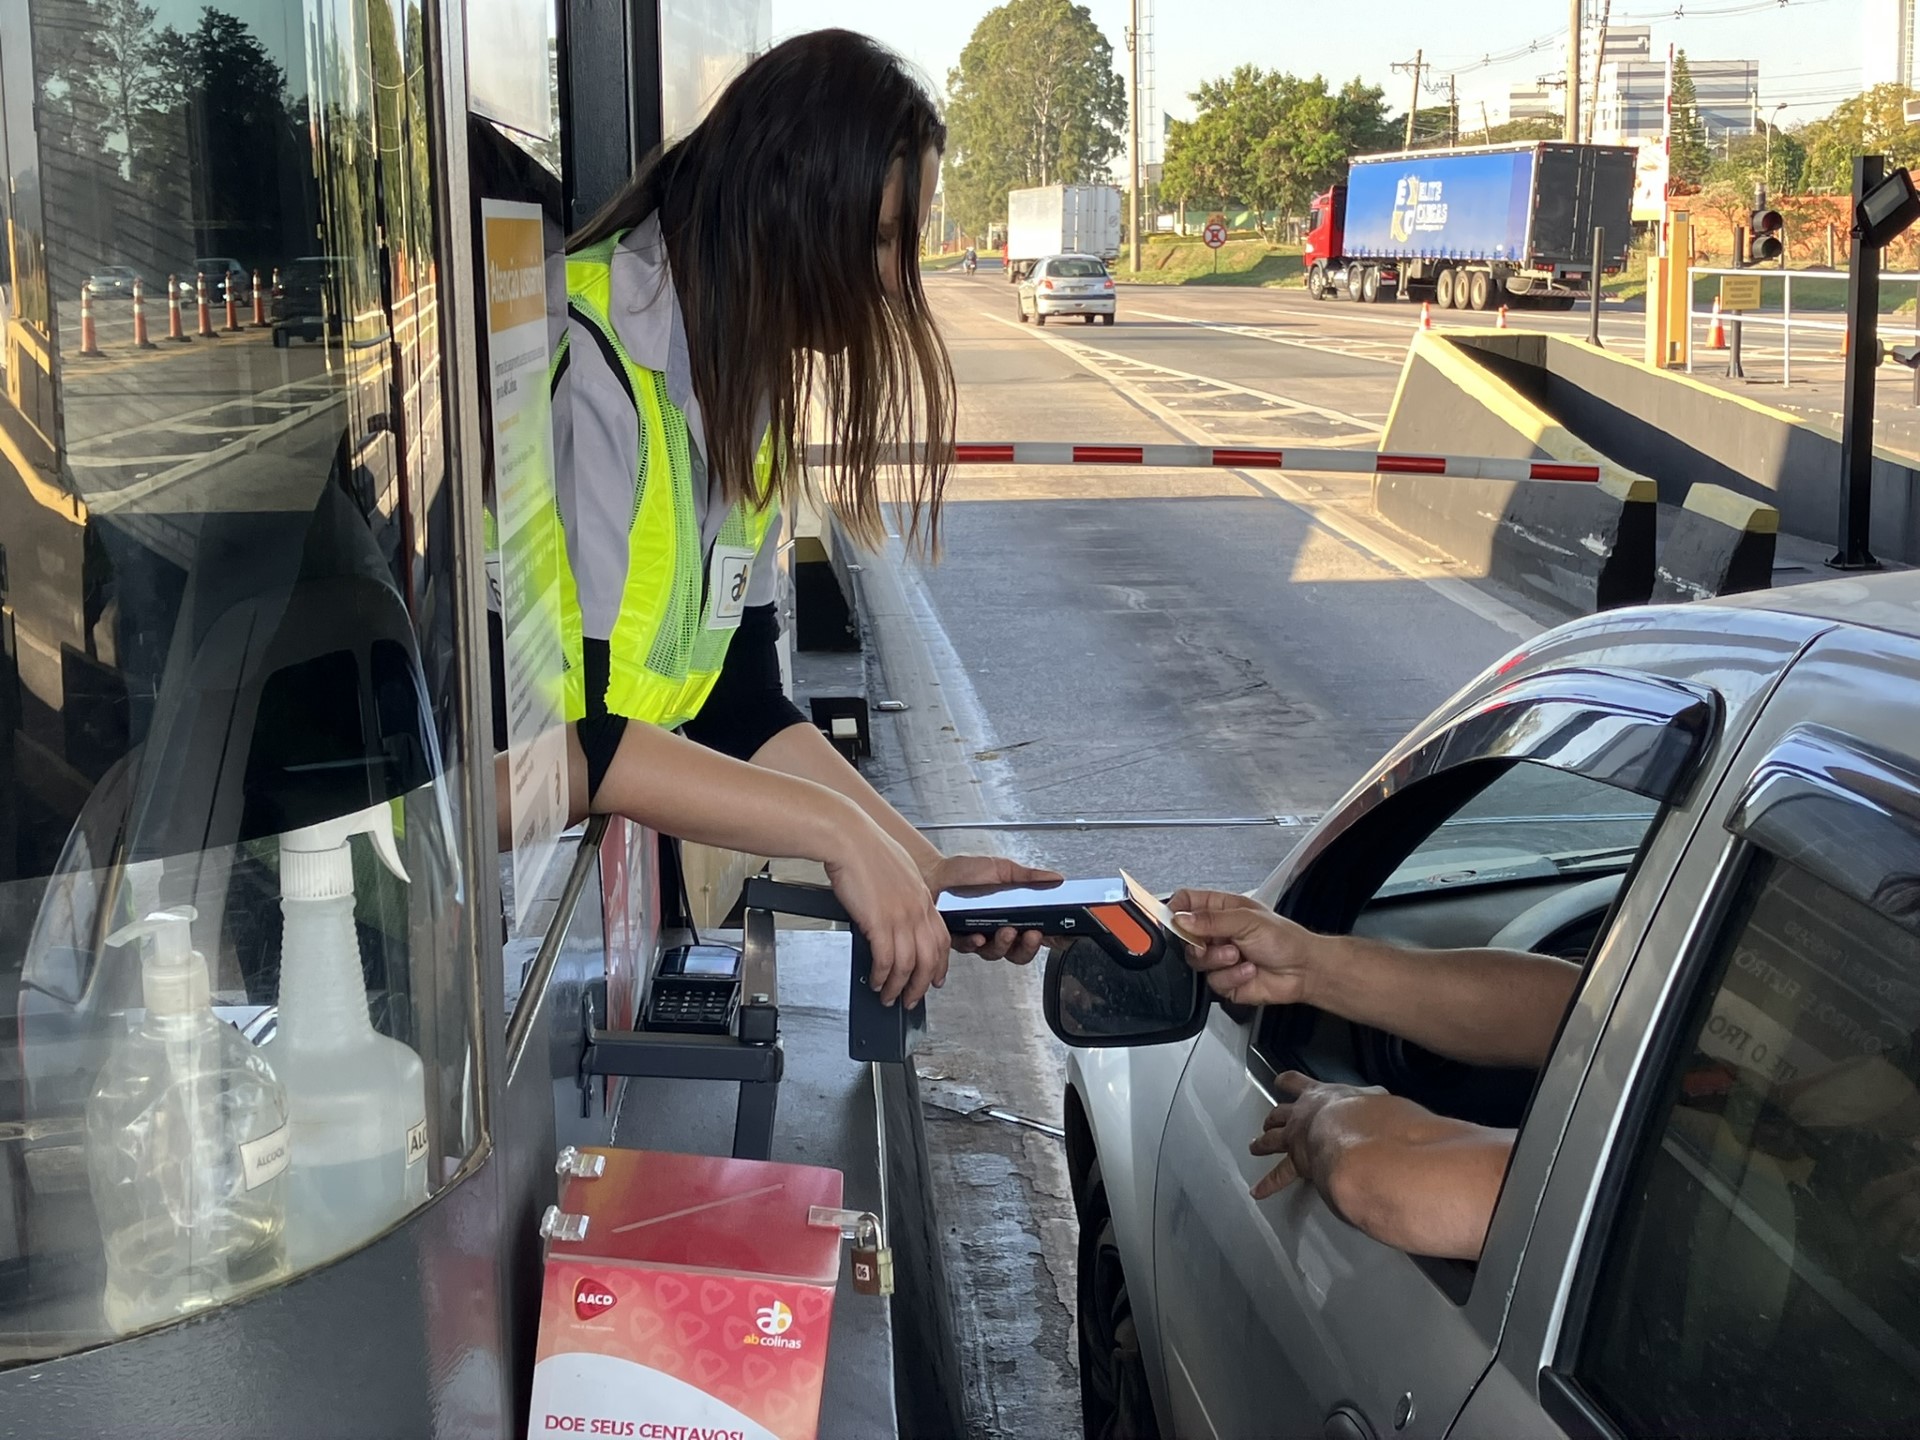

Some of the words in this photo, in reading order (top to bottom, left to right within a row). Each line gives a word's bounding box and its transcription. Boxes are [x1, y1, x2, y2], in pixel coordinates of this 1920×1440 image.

[857, 1265, 868, 1279] 06
[577, 1292, 613, 1306] AACD
[545, 1415, 585, 1432] DOE
[591, 1419, 635, 1436] SEUS
